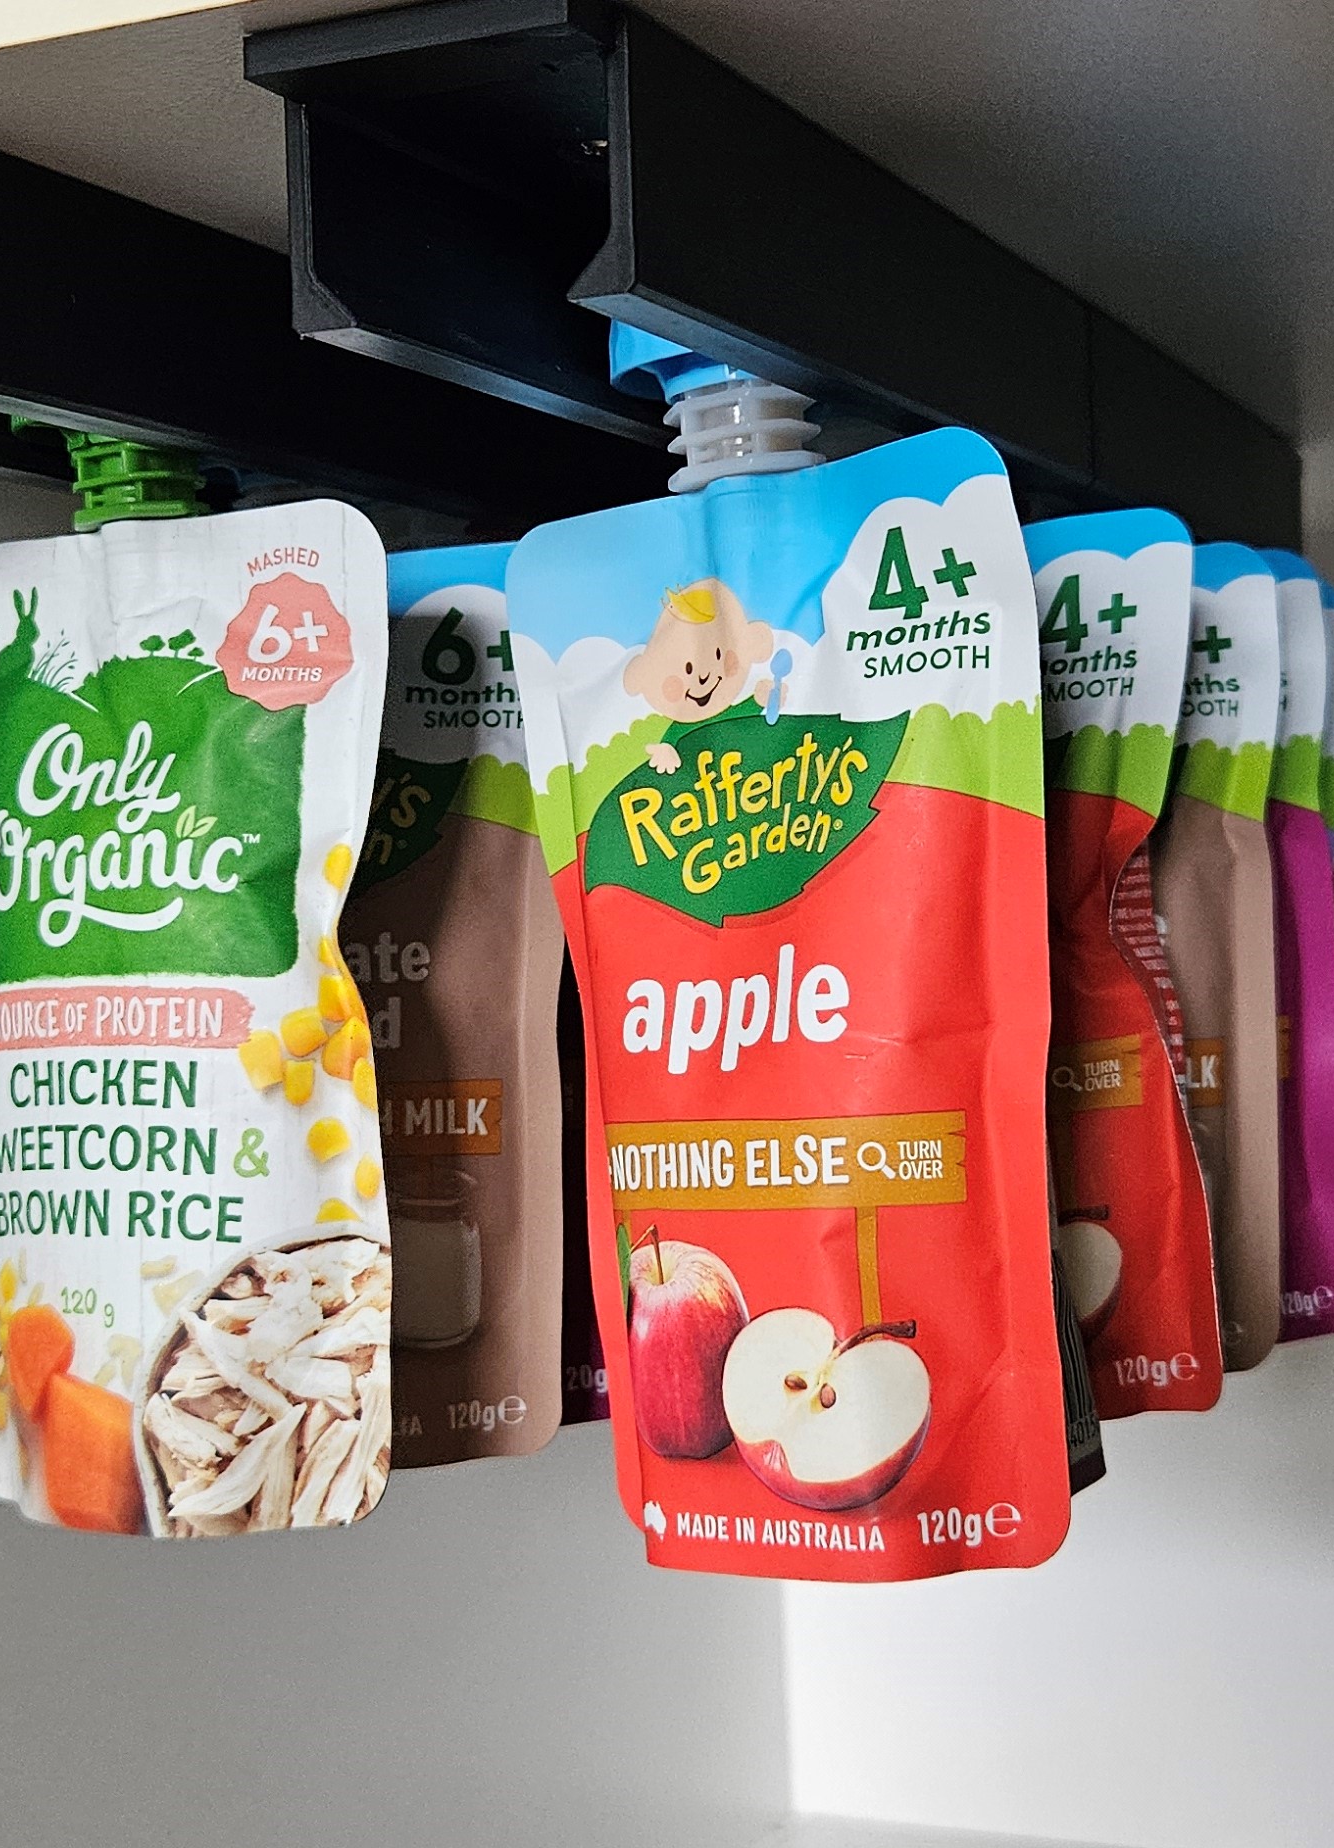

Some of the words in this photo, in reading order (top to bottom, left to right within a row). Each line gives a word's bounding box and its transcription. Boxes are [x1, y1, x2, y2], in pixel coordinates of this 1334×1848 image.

[247, 547, 320, 577] MASHED
[868, 526, 977, 620] 4+
[247, 604, 328, 664] 6+
[846, 609, 991, 653] months
[241, 666, 323, 683] MONTHS
[863, 645, 990, 679] SMOOTH
[1041, 645, 1138, 675] onths
[404, 682, 521, 705] month
[1044, 677, 1134, 702] MOOTH
[1181, 699, 1239, 717] OOTH
[18, 720, 181, 834] Only
[619, 732, 868, 866] Rafferty's
[64, 999, 88, 1036] OF
[94, 996, 224, 1038] PROTEIN
[623, 943, 849, 1074] apple
[10, 1059, 197, 1109] CHICKEN
[1083, 1059, 1119, 1078] TURN
[1084, 1073, 1121, 1091] OVER
[404, 1097, 488, 1136] MILK
[233, 1128, 270, 1178] &
[611, 1138, 735, 1191] NOTHING
[745, 1134, 850, 1187] ELSE
[897, 1138, 943, 1160] TURN
[898, 1159, 944, 1181] OVER
[677, 1512, 729, 1541] MADE
[735, 1516, 755, 1543] IN
[761, 1518, 885, 1552] AUSTRALIA
